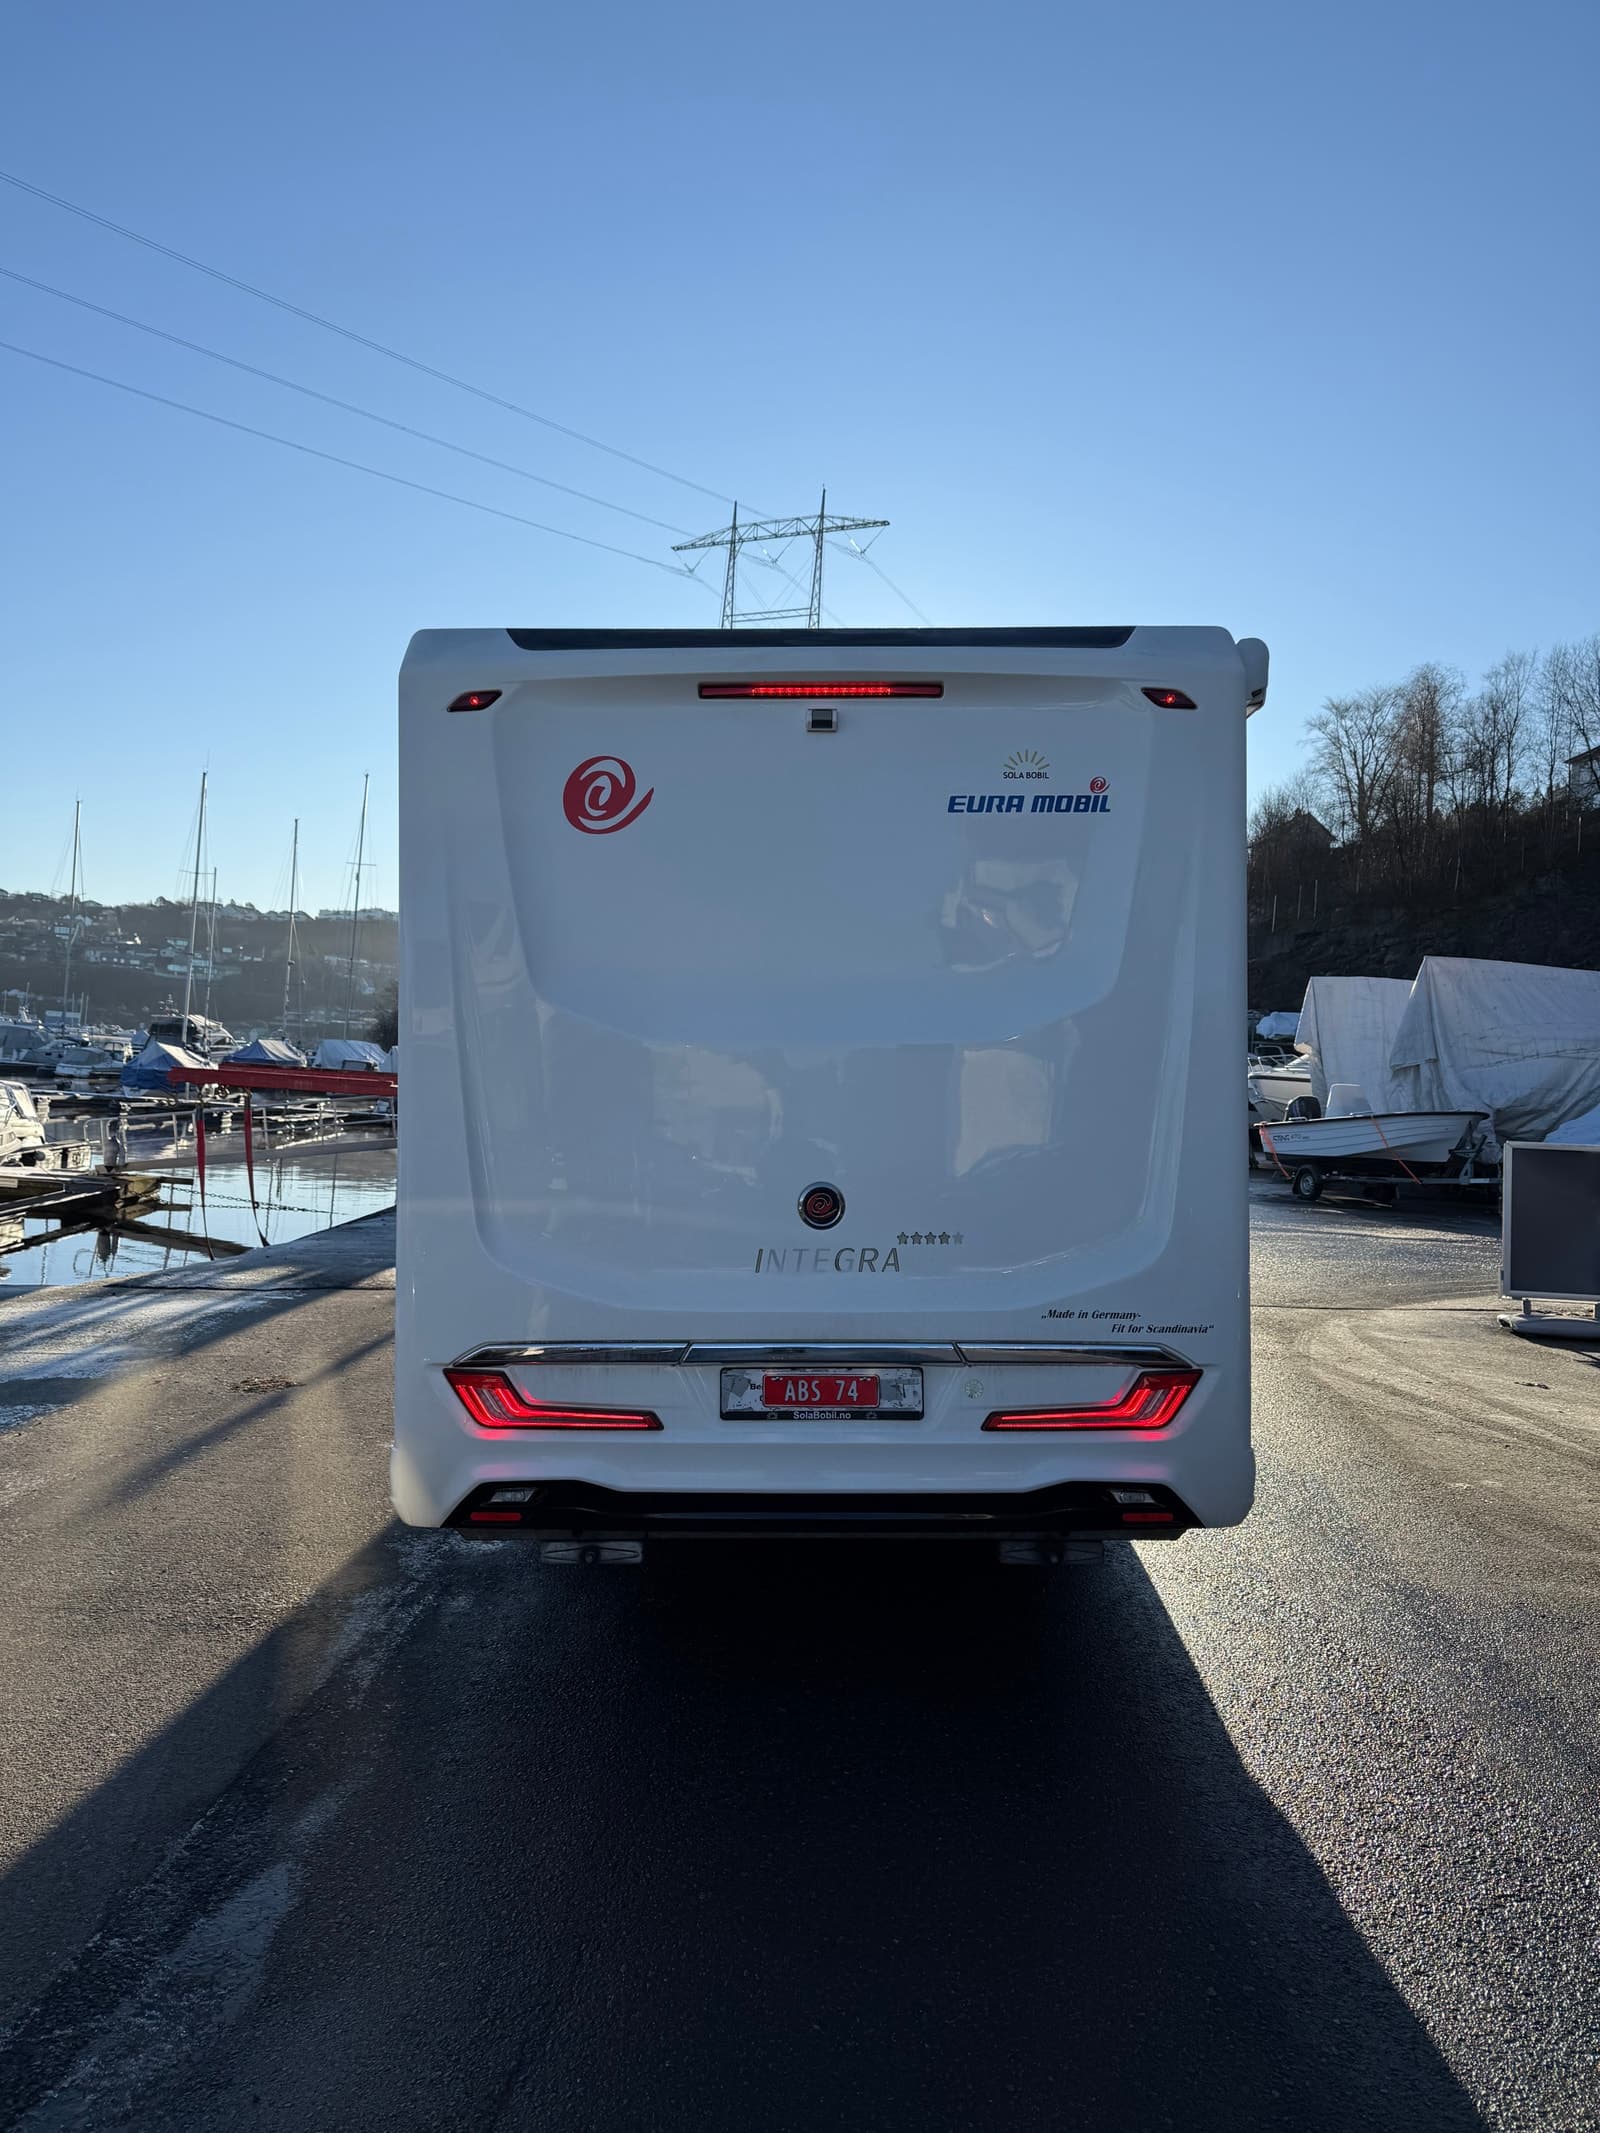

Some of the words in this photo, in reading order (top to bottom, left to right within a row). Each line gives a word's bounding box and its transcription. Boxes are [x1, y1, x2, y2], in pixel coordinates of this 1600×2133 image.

[1003, 771, 1024, 780] SOLA
[1026, 771, 1050, 780] BOBIL
[948, 794, 1025, 813] EURA
[1030, 794, 1111, 813] MOBIL
[755, 1248, 900, 1273] INTEGRA
[1077, 1309, 1089, 1319] in
[1111, 1324, 1125, 1333] Fit
[1127, 1324, 1144, 1333] for
[784, 1380, 821, 1402] ABS
[835, 1380, 859, 1402] 74
[793, 1411, 852, 1420] SolaBobil.no
